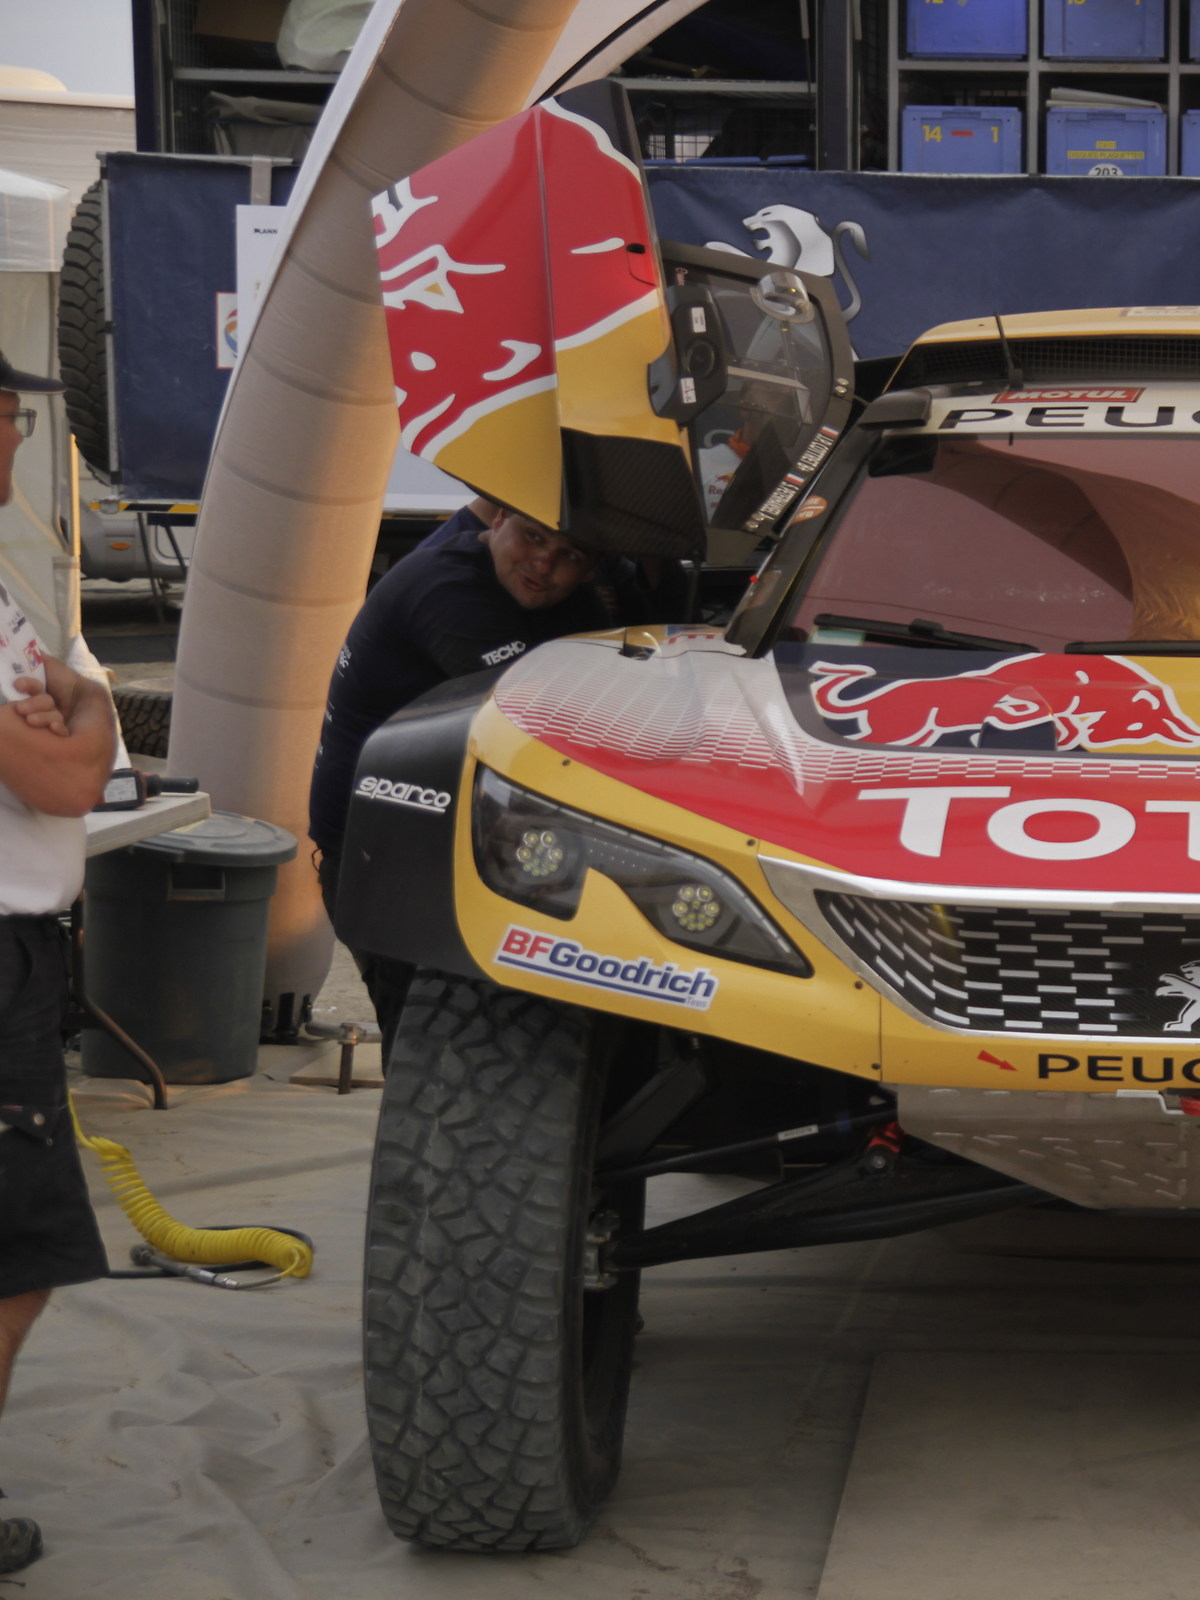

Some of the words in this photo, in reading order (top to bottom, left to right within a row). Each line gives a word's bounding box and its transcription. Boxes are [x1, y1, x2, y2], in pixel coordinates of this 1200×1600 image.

[922, 125, 943, 143] 14
[990, 126, 1000, 143] 1
[1008, 388, 1130, 402] MOTUL
[358, 776, 452, 808] sparco
[501, 928, 717, 999] BFGoodrich
[685, 994, 708, 1008] Tires
